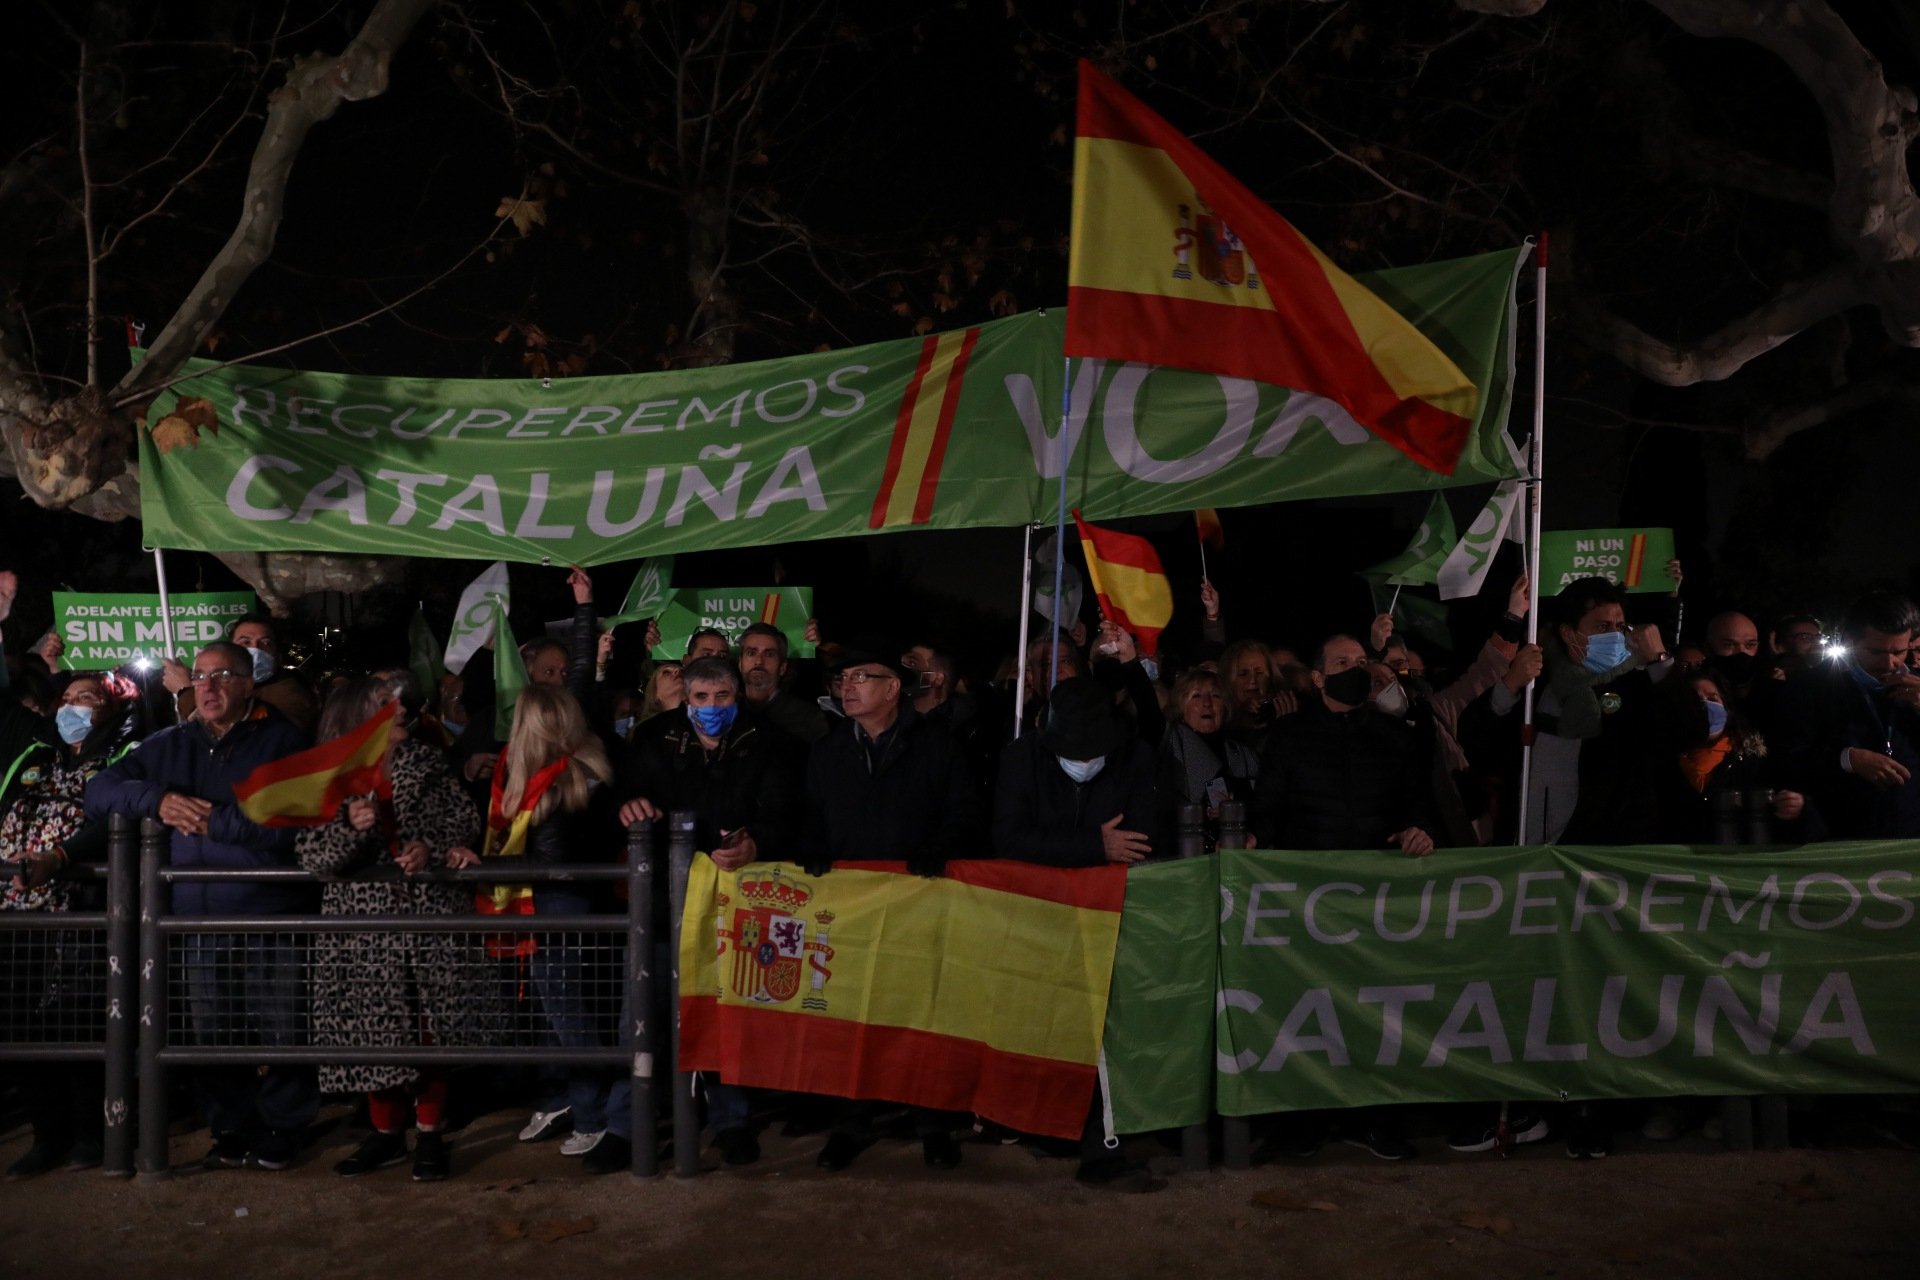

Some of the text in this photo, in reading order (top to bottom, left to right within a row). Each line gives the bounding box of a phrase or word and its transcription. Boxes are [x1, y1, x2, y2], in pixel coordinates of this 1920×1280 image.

[232, 365, 869, 440] RECUPEREMOS
[226, 443, 828, 540] CATALUÑA
[1576, 539, 1624, 552] NI UN
[1573, 555, 1621, 568] PASO
[65, 605, 151, 617] ADELANTE
[705, 599, 755, 612] NI UN
[701, 616, 751, 630] PASO
[65, 620, 124, 642] SIN
[70, 646, 84, 659] A
[89, 646, 143, 659] NADA
[1217, 950, 1877, 1074] CATALUÑA
